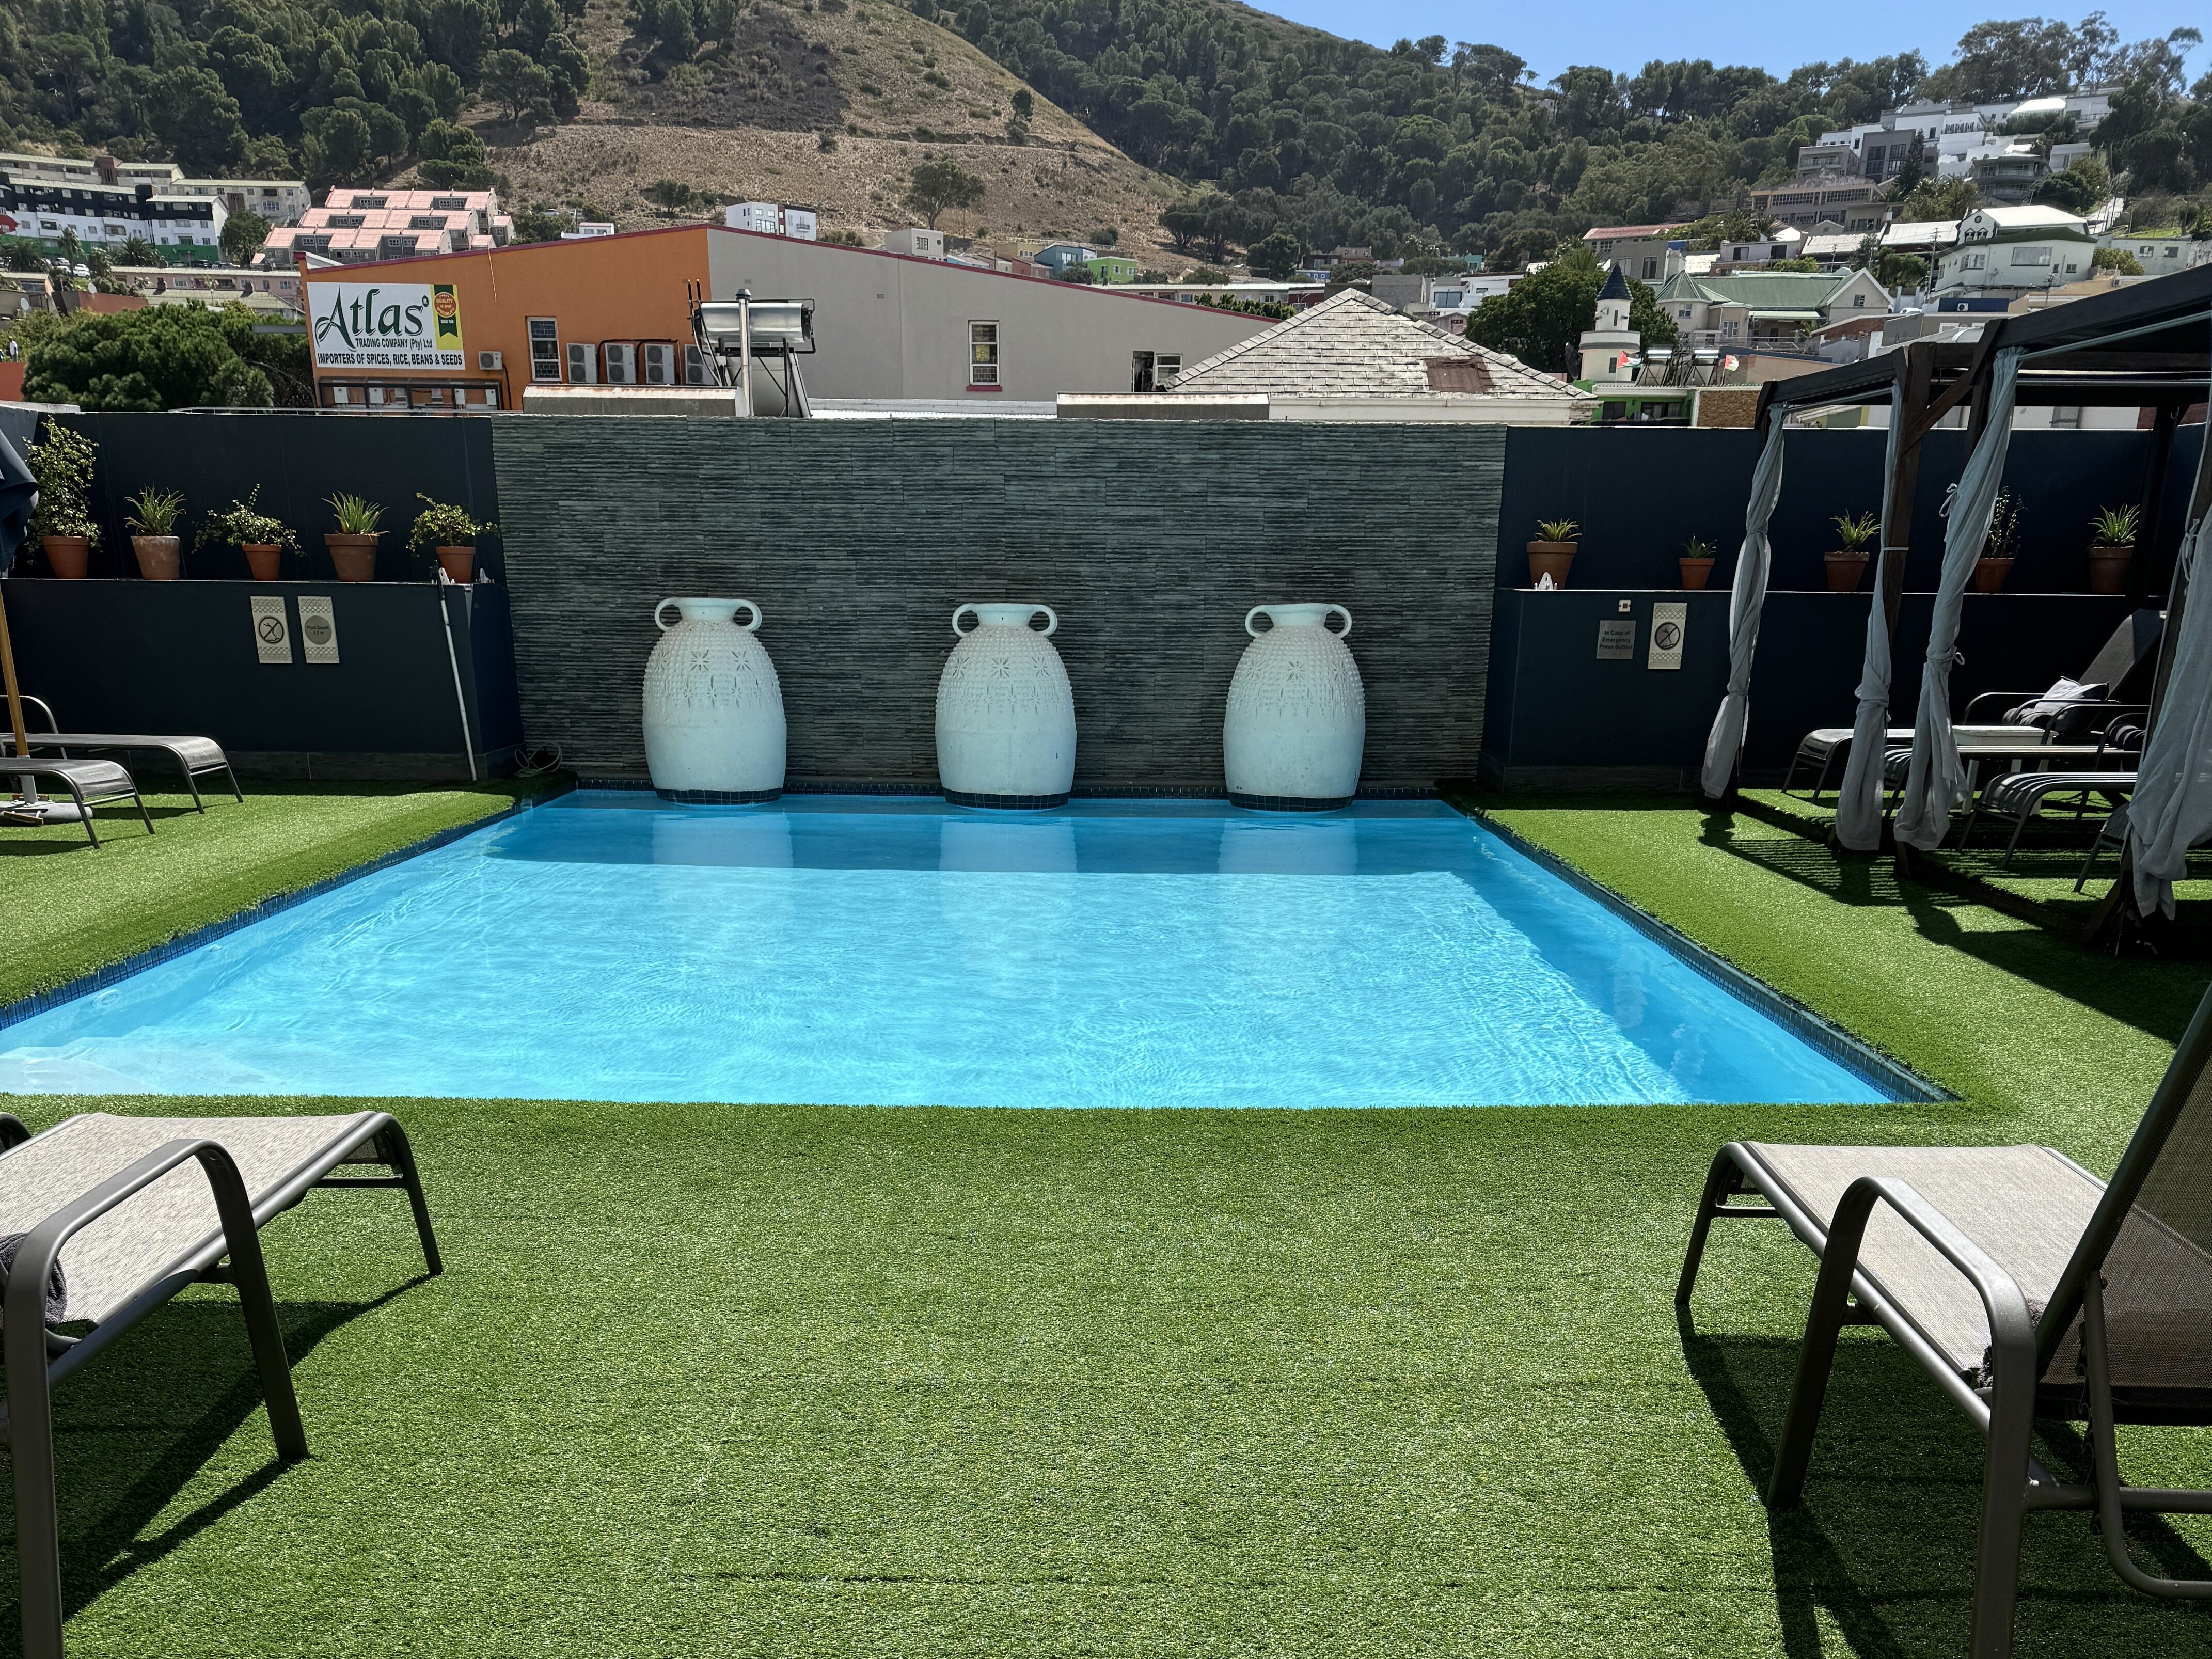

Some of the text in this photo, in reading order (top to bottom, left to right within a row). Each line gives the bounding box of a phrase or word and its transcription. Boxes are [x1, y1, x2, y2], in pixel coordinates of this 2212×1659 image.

[314, 285, 424, 352] Atlas
[355, 338, 433, 351] TRADING COMPANY (Pty) Ltd
[318, 353, 462, 367] IMPORTERS OF SPICES, RICE, BEANS & SEEDS
